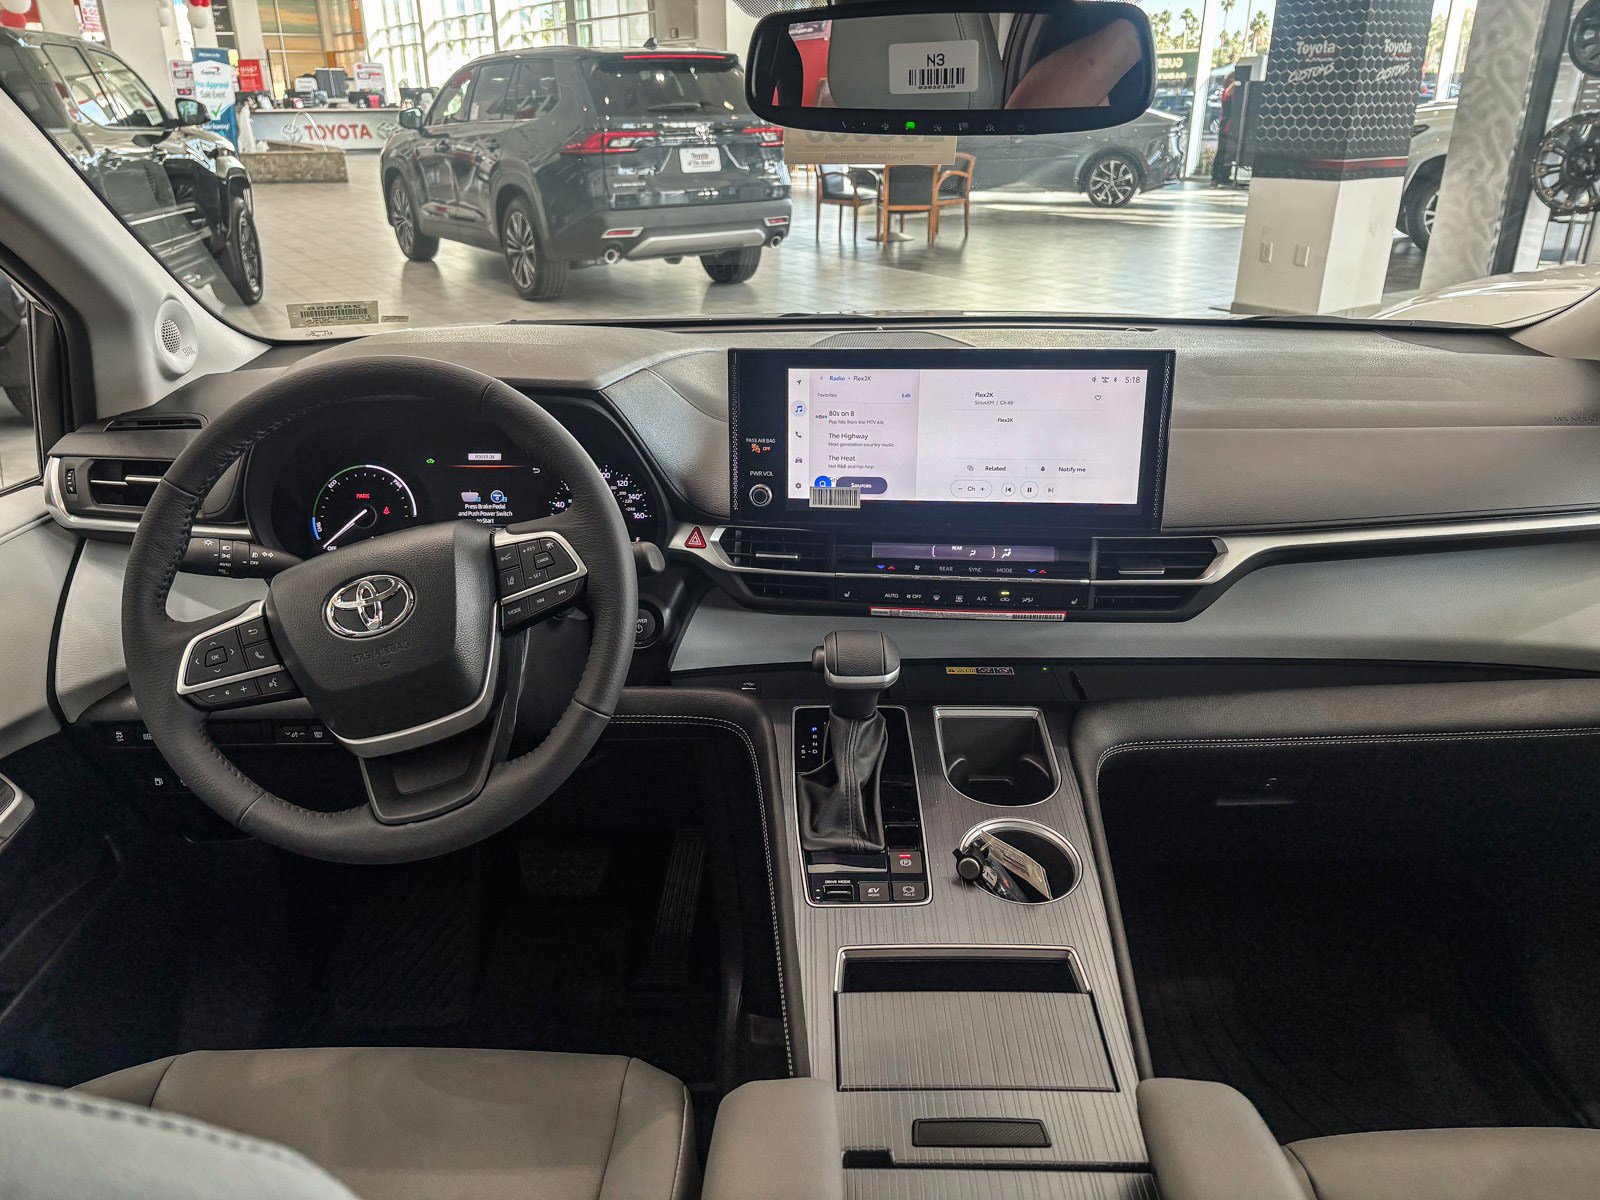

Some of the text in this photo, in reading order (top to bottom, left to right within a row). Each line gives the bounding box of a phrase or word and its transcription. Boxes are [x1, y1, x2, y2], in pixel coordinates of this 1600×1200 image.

[1296, 40, 1336, 58] Toyota
[1384, 38, 1412, 56] Toyota
[304, 123, 373, 140] TOYOTA
[328, 480, 337, 488] ECO
